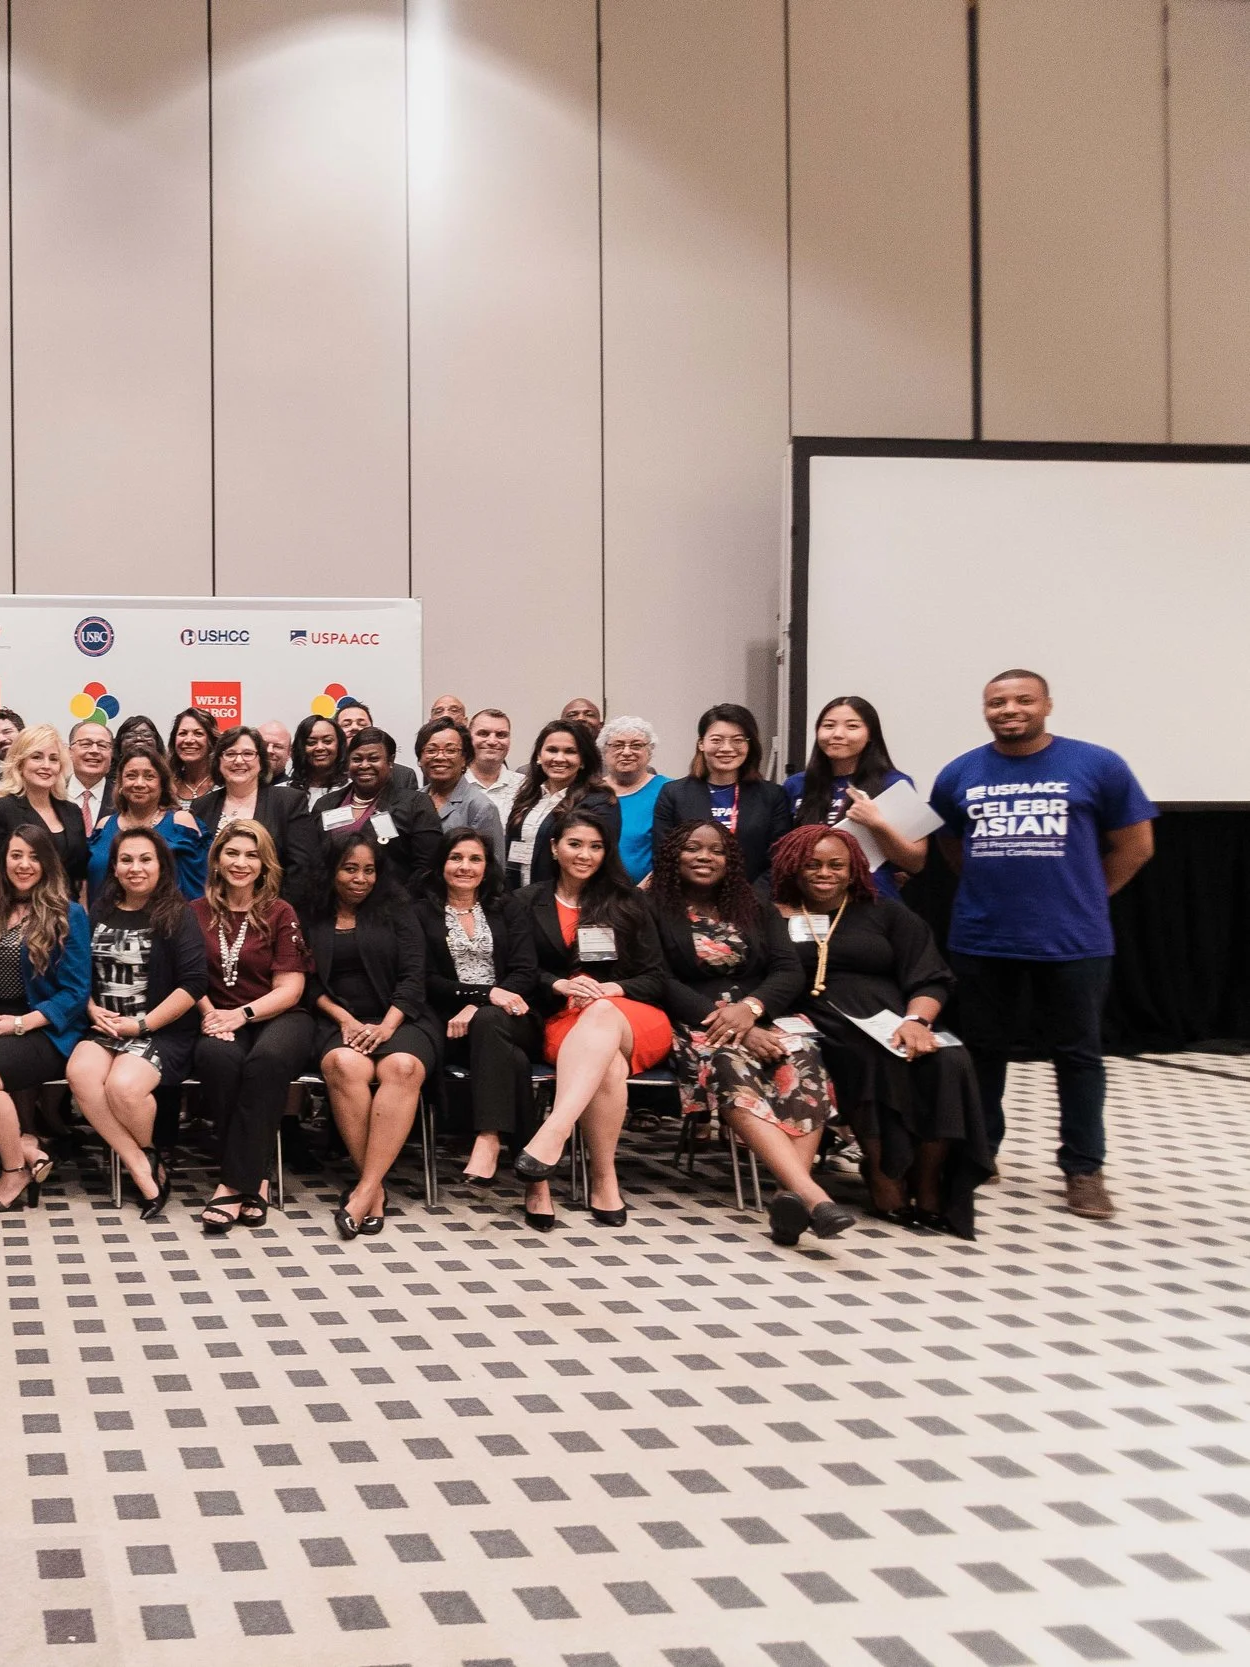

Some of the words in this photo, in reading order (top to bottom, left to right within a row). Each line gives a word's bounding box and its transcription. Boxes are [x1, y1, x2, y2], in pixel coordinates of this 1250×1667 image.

[81, 631, 109, 643] USBC
[197, 629, 250, 642] USHCC
[311, 632, 380, 645] USPAACC
[194, 695, 238, 706] WELLS
[987, 781, 1070, 796] USPAACC
[967, 798, 1070, 820] CELEBR
[970, 815, 1069, 838] ASIAN
